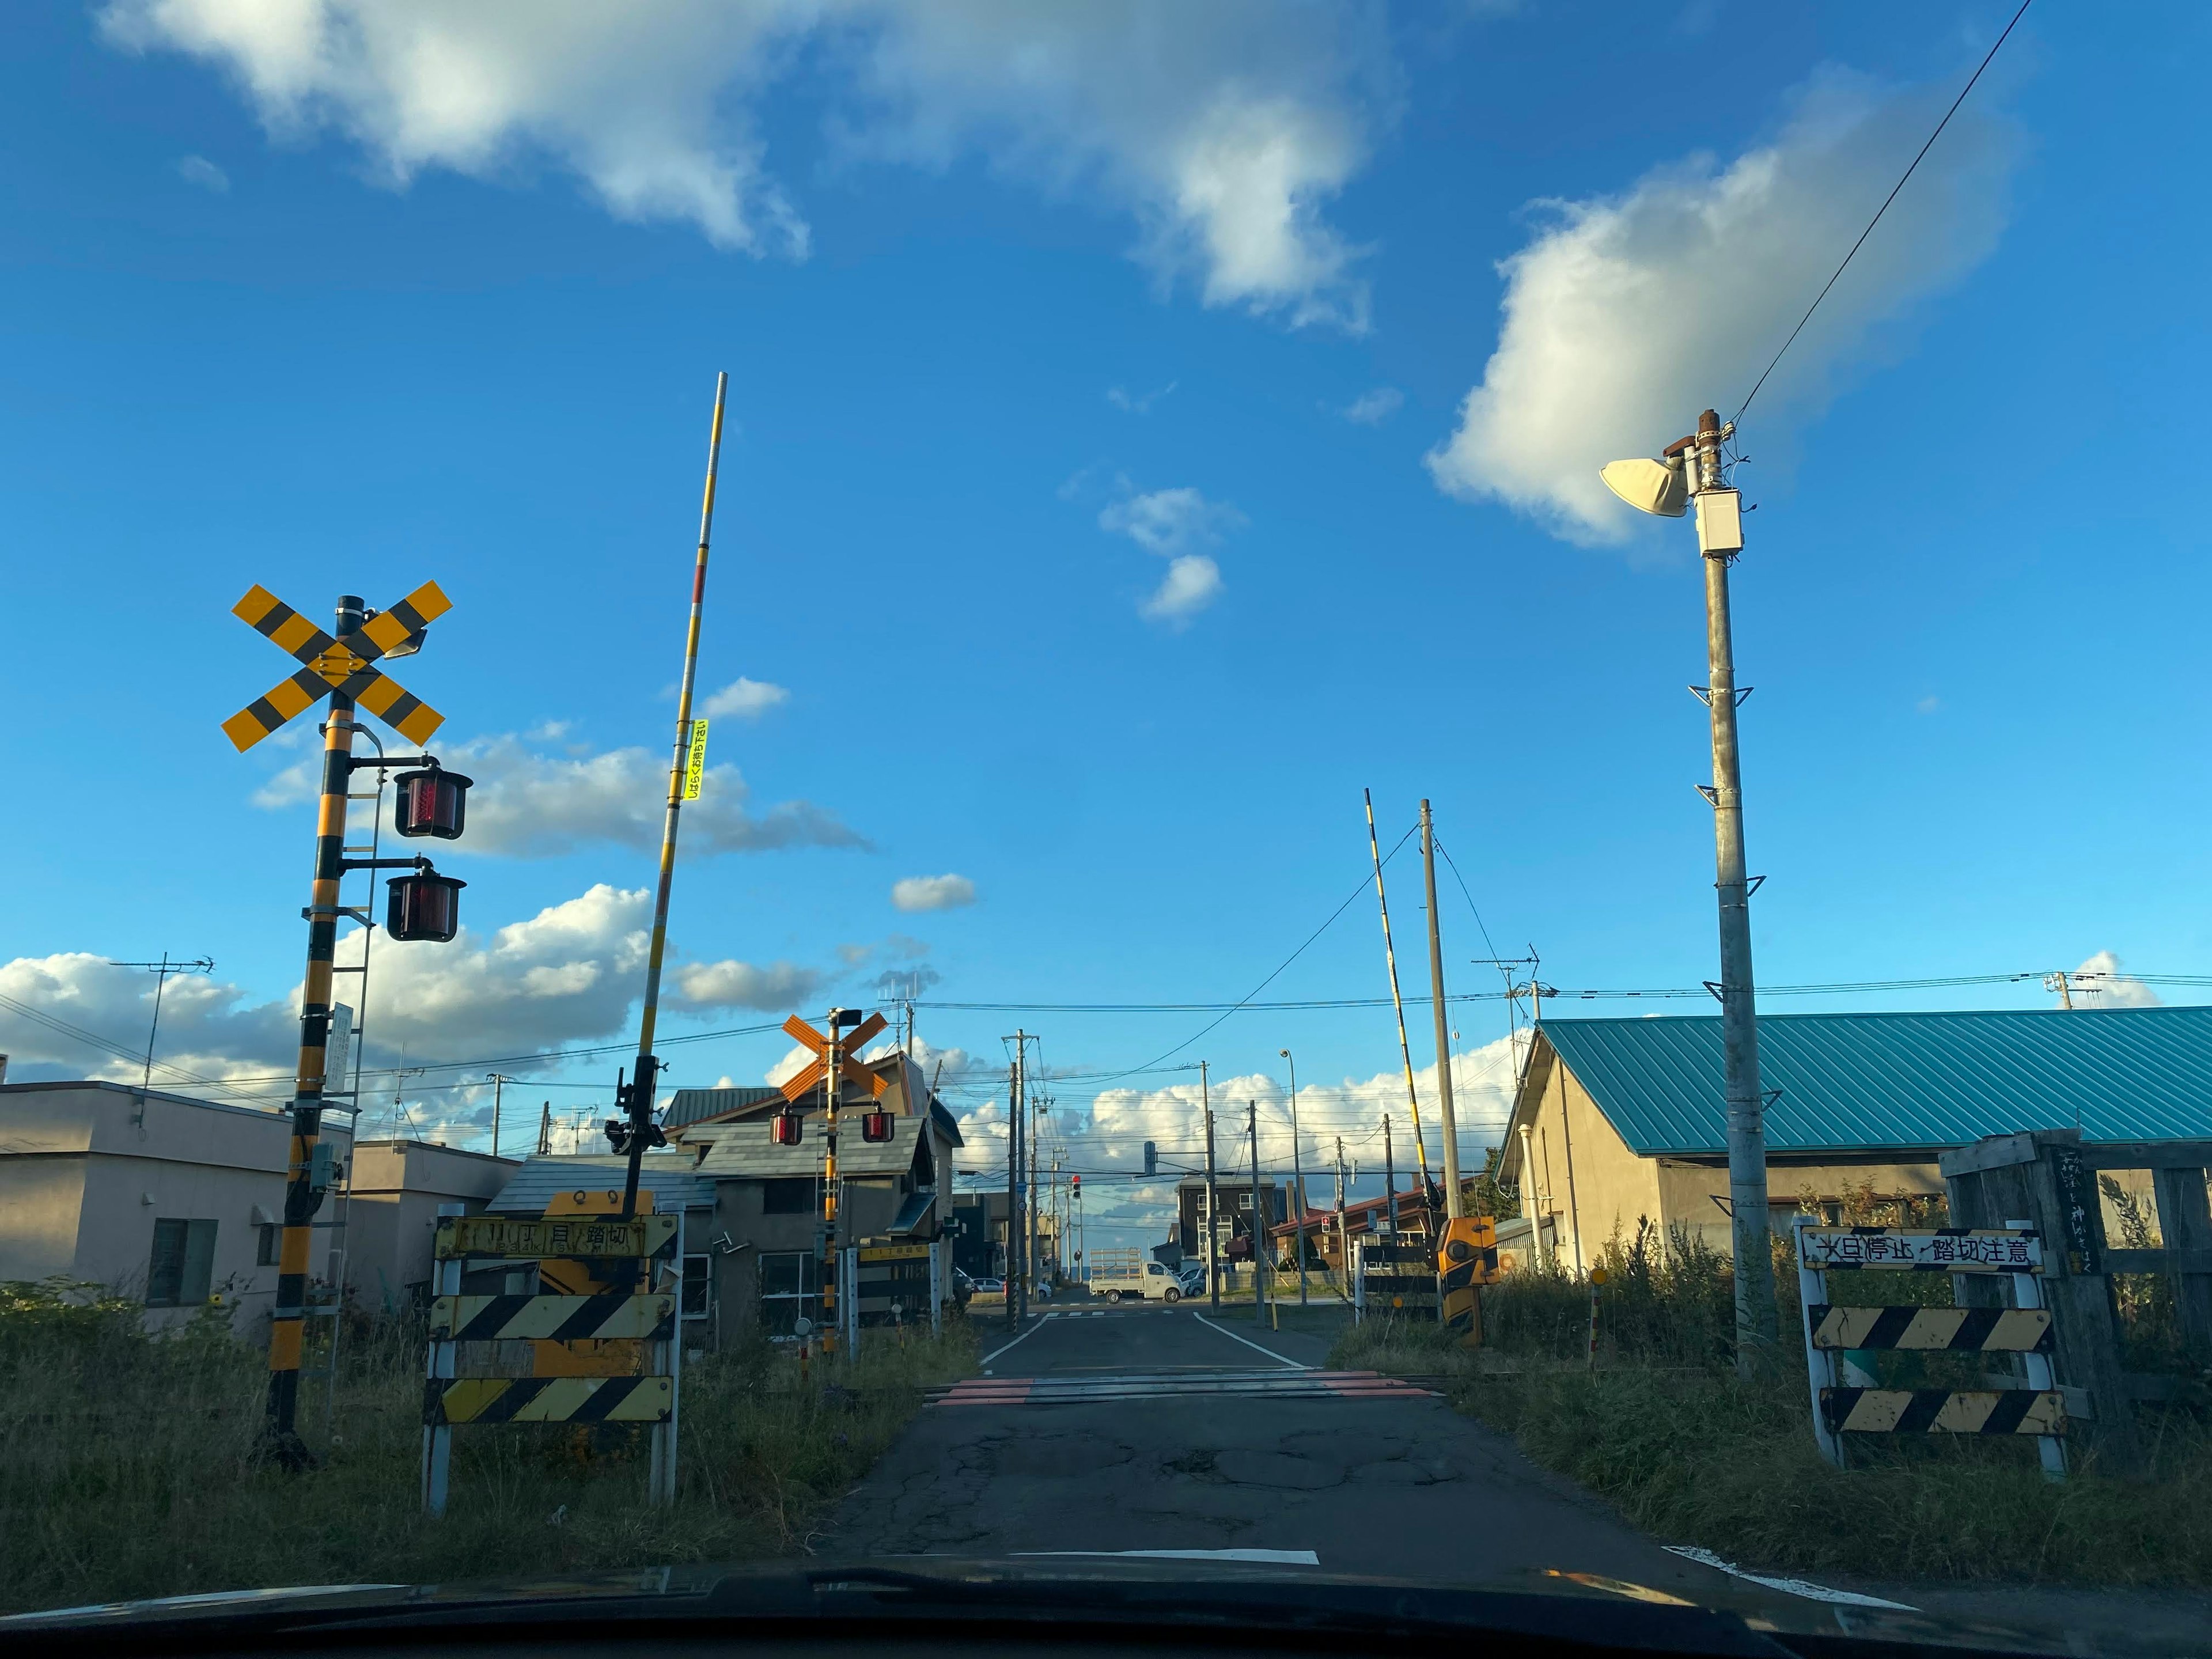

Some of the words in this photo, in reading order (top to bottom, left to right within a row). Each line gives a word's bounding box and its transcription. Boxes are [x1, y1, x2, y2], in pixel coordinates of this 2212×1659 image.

[688, 721, 706, 799] しばらくお待ち下さい
[1816, 1237, 1915, 1260] 一旦停止
[1933, 1238, 2030, 1263] 踏切注意
